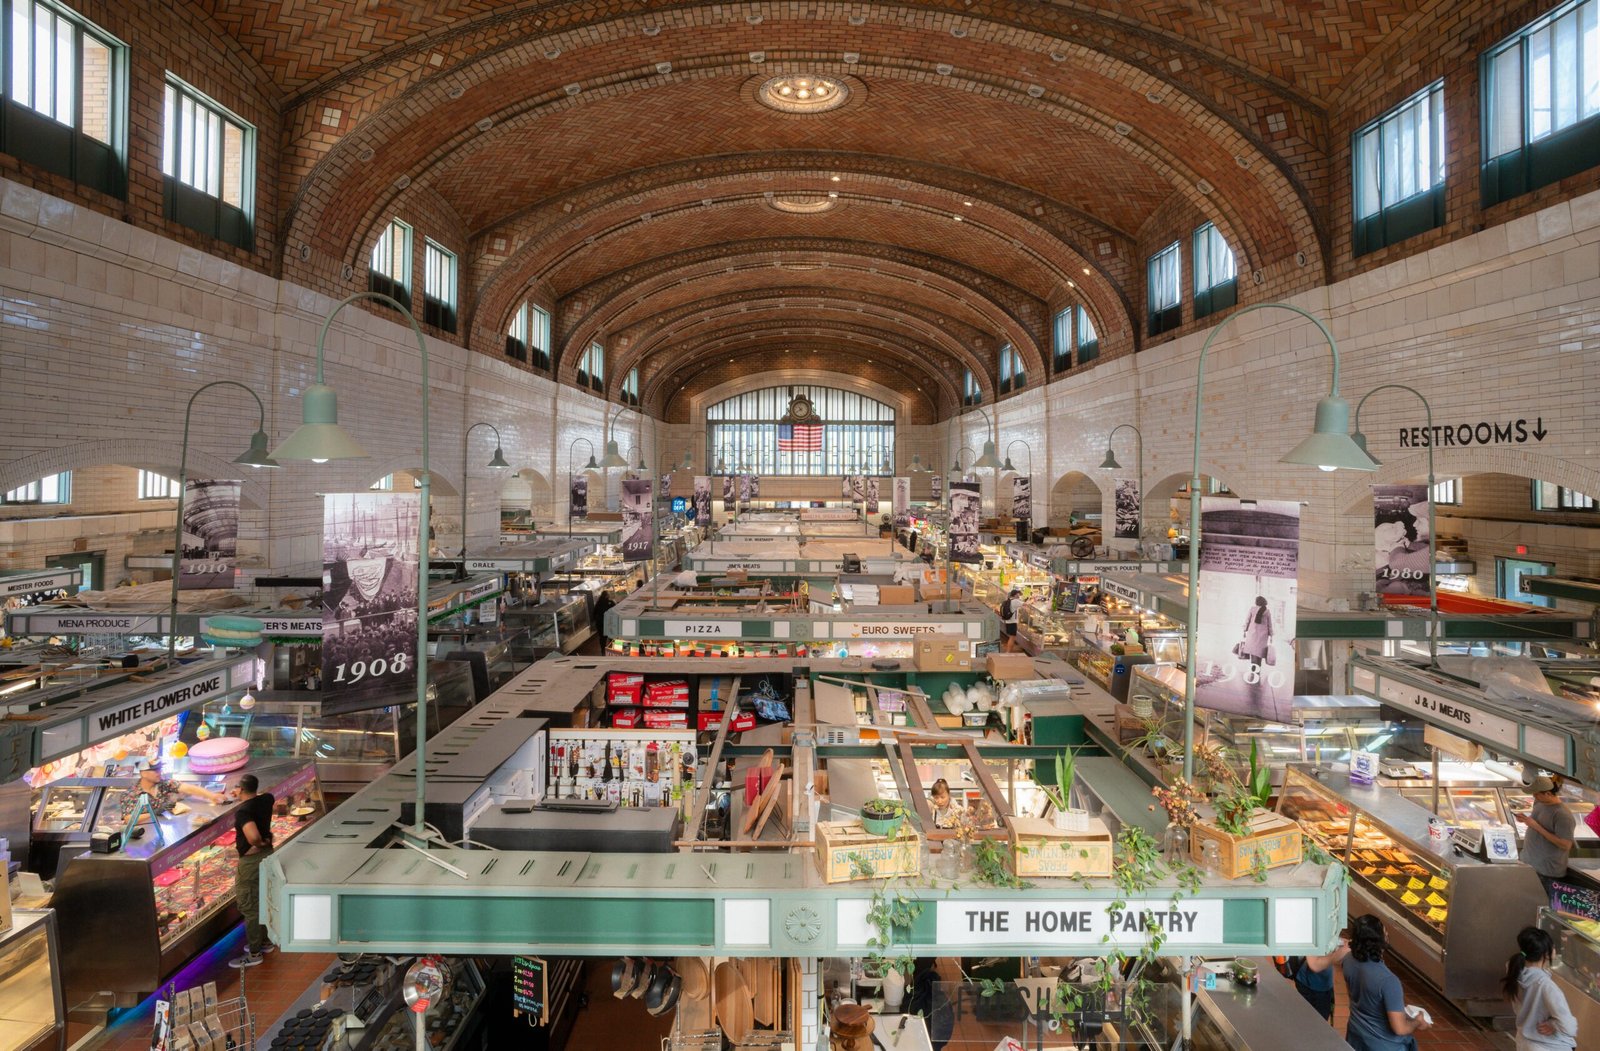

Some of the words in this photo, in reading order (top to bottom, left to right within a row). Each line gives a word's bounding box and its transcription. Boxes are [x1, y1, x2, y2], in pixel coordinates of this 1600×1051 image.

[1400, 419, 1528, 447] RESTROOMS
[627, 541, 649, 551] 1917
[187, 563, 227, 576] 1910
[1382, 567, 1424, 580] 1980
[8, 583, 32, 592] MEISTER
[34, 580, 54, 588] FOODS
[58, 620, 84, 628] MENA
[86, 619, 130, 628] PRODUCE
[290, 622, 323, 630] MEATS
[862, 626, 889, 634] EURO
[893, 626, 936, 634] SWEETS
[333, 652, 407, 684] 1908
[1202, 660, 1285, 688] 1980
[99, 704, 142, 731] WHITE
[144, 686, 190, 715] FLOWER
[193, 676, 220, 697] CAKE
[1415, 695, 1420, 704] J
[1422, 697, 1428, 708] &
[1430, 700, 1436, 710] J
[1439, 702, 1470, 724] MEATS
[1552, 882, 1576, 894] Order
[966, 911, 1009, 932] THE
[1026, 911, 1092, 932] HOME
[1109, 911, 1198, 932] PANTRY
